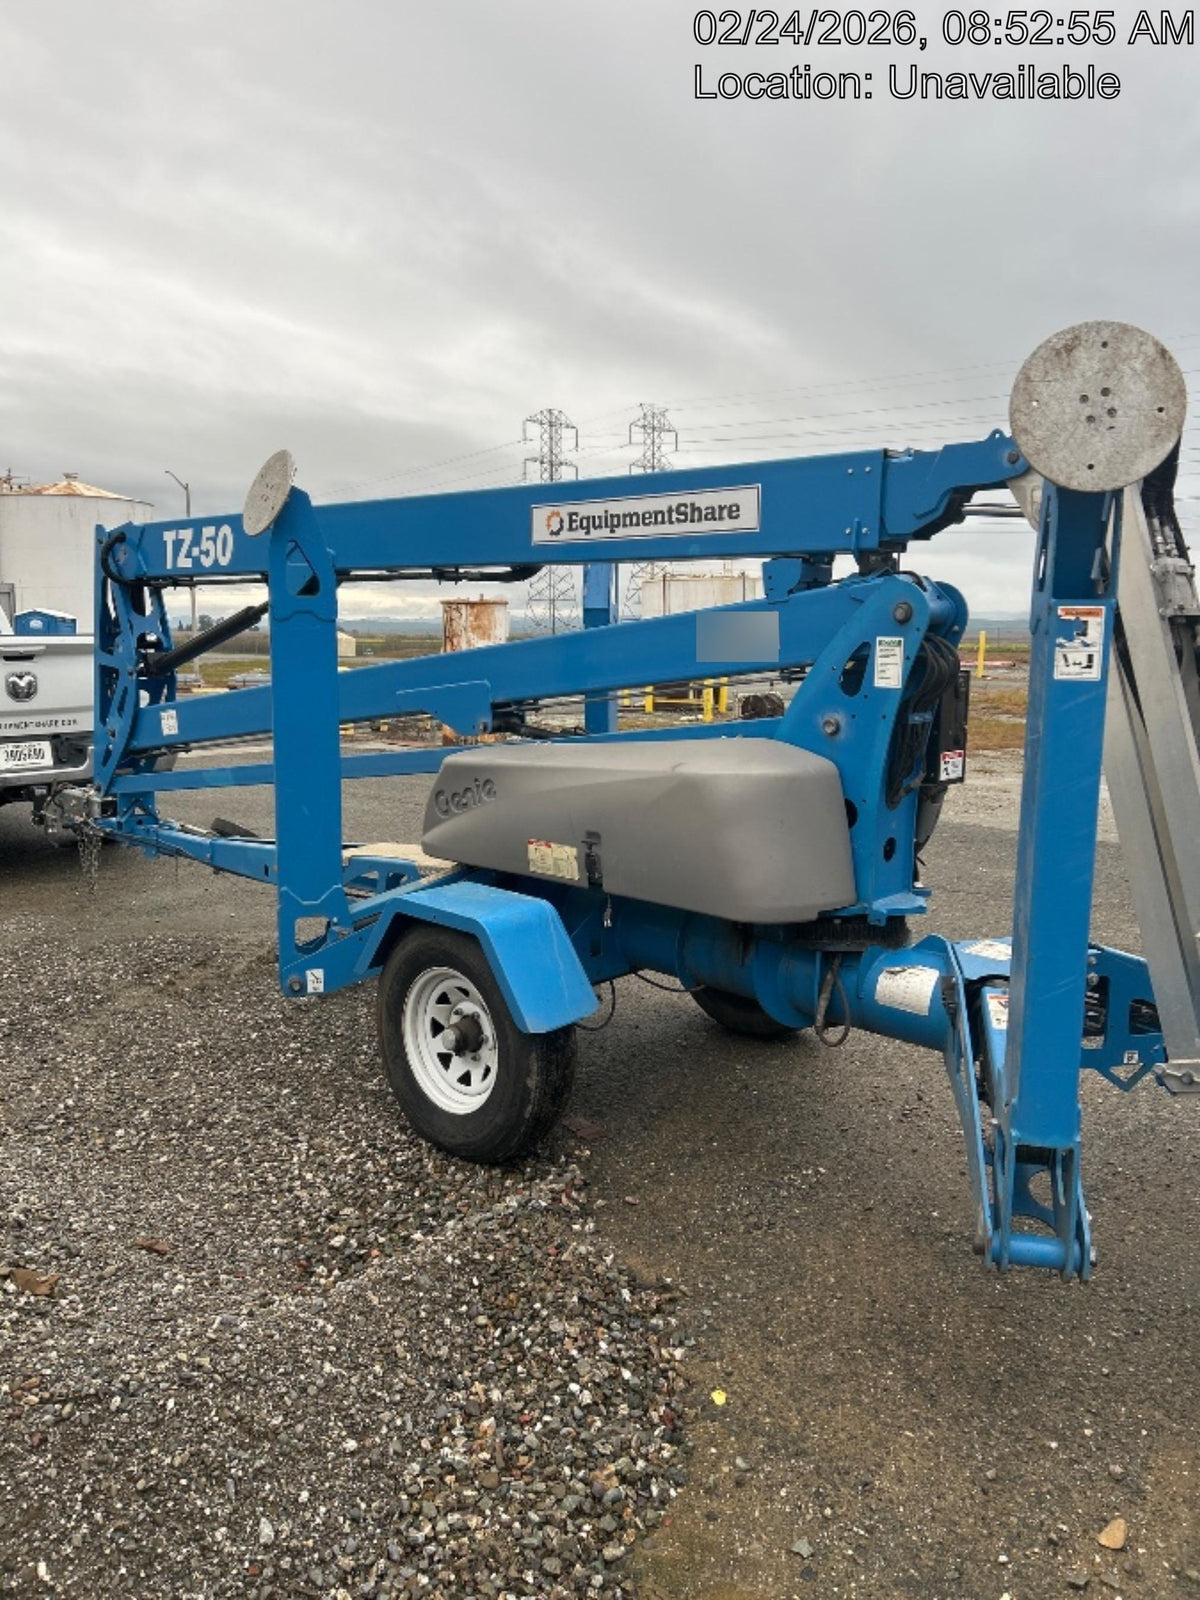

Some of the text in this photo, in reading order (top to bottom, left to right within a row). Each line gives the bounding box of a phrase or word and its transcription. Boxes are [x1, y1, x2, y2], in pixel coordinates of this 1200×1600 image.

[567, 502, 740, 535] EquipmentShare
[163, 524, 234, 570] TZ-50
[434, 776, 497, 819] Genie
